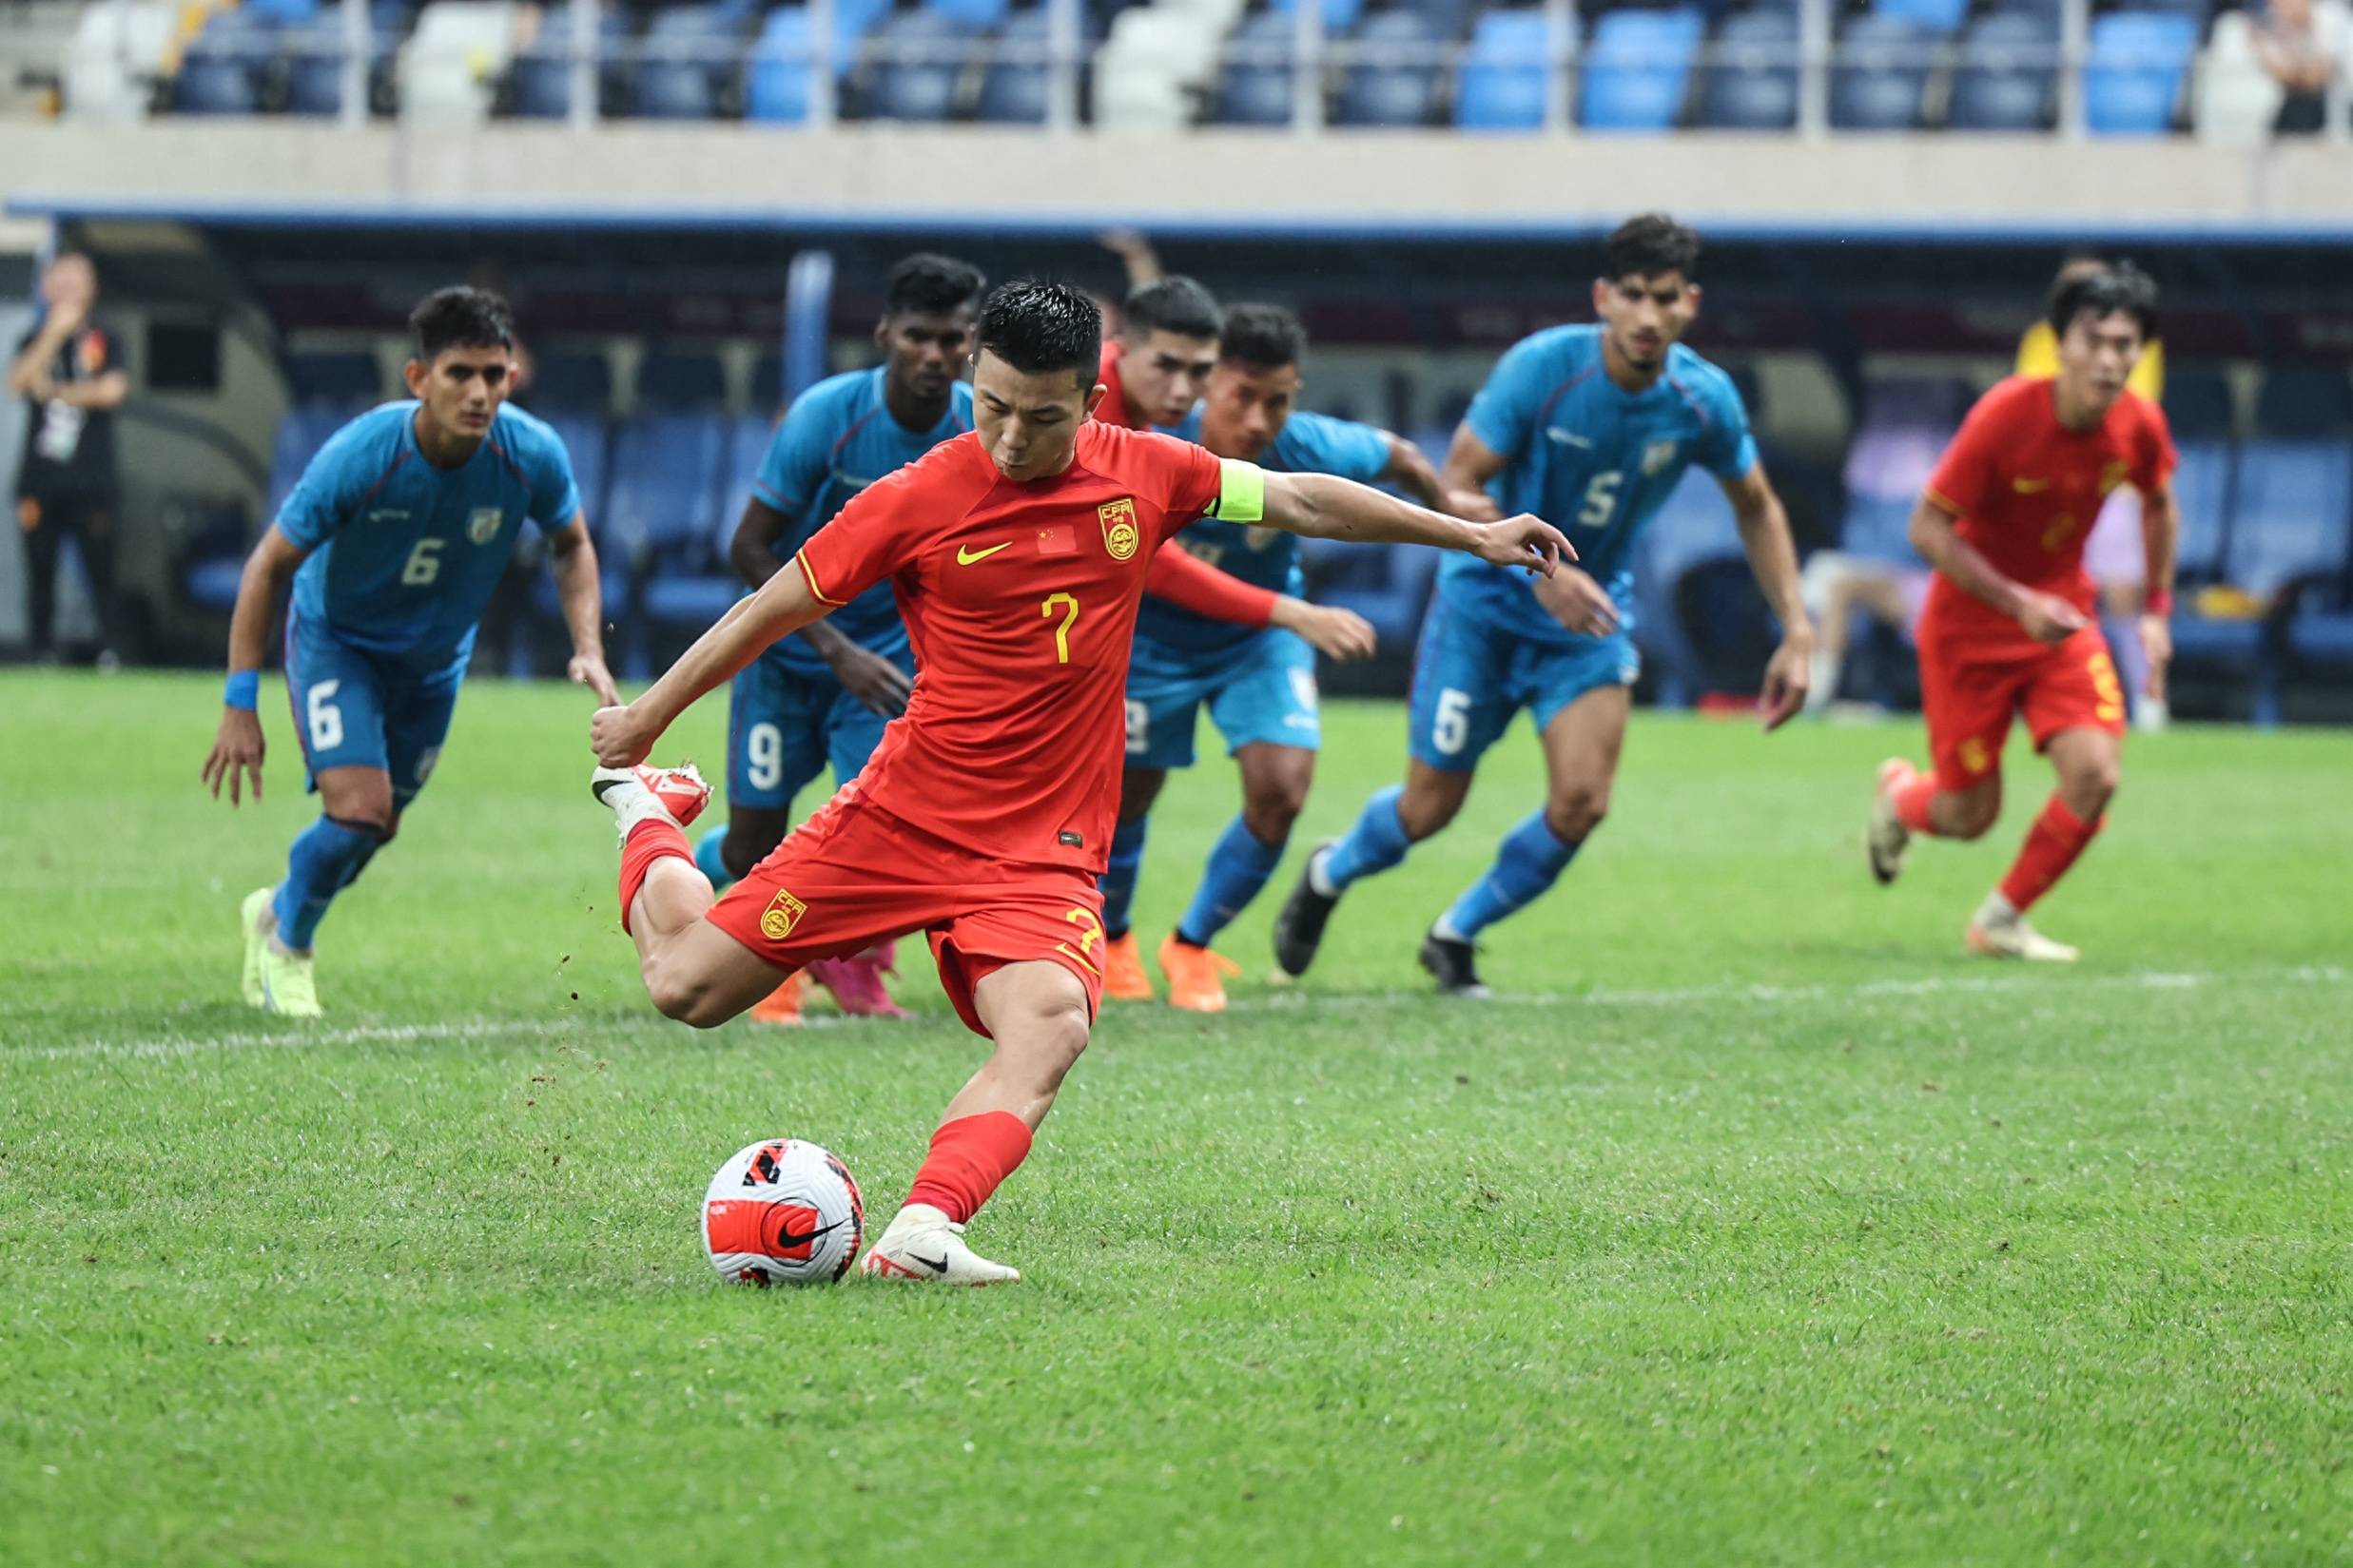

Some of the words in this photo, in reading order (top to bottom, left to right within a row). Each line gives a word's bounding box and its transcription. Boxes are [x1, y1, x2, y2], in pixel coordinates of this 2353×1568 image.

[1577, 470, 1624, 528] 5
[401, 537, 445, 586] 6
[1040, 592, 1079, 664] 7
[307, 678, 343, 752] 6
[1431, 687, 1471, 755] 5
[747, 721, 783, 791] 9
[1064, 906, 1101, 955] 7
